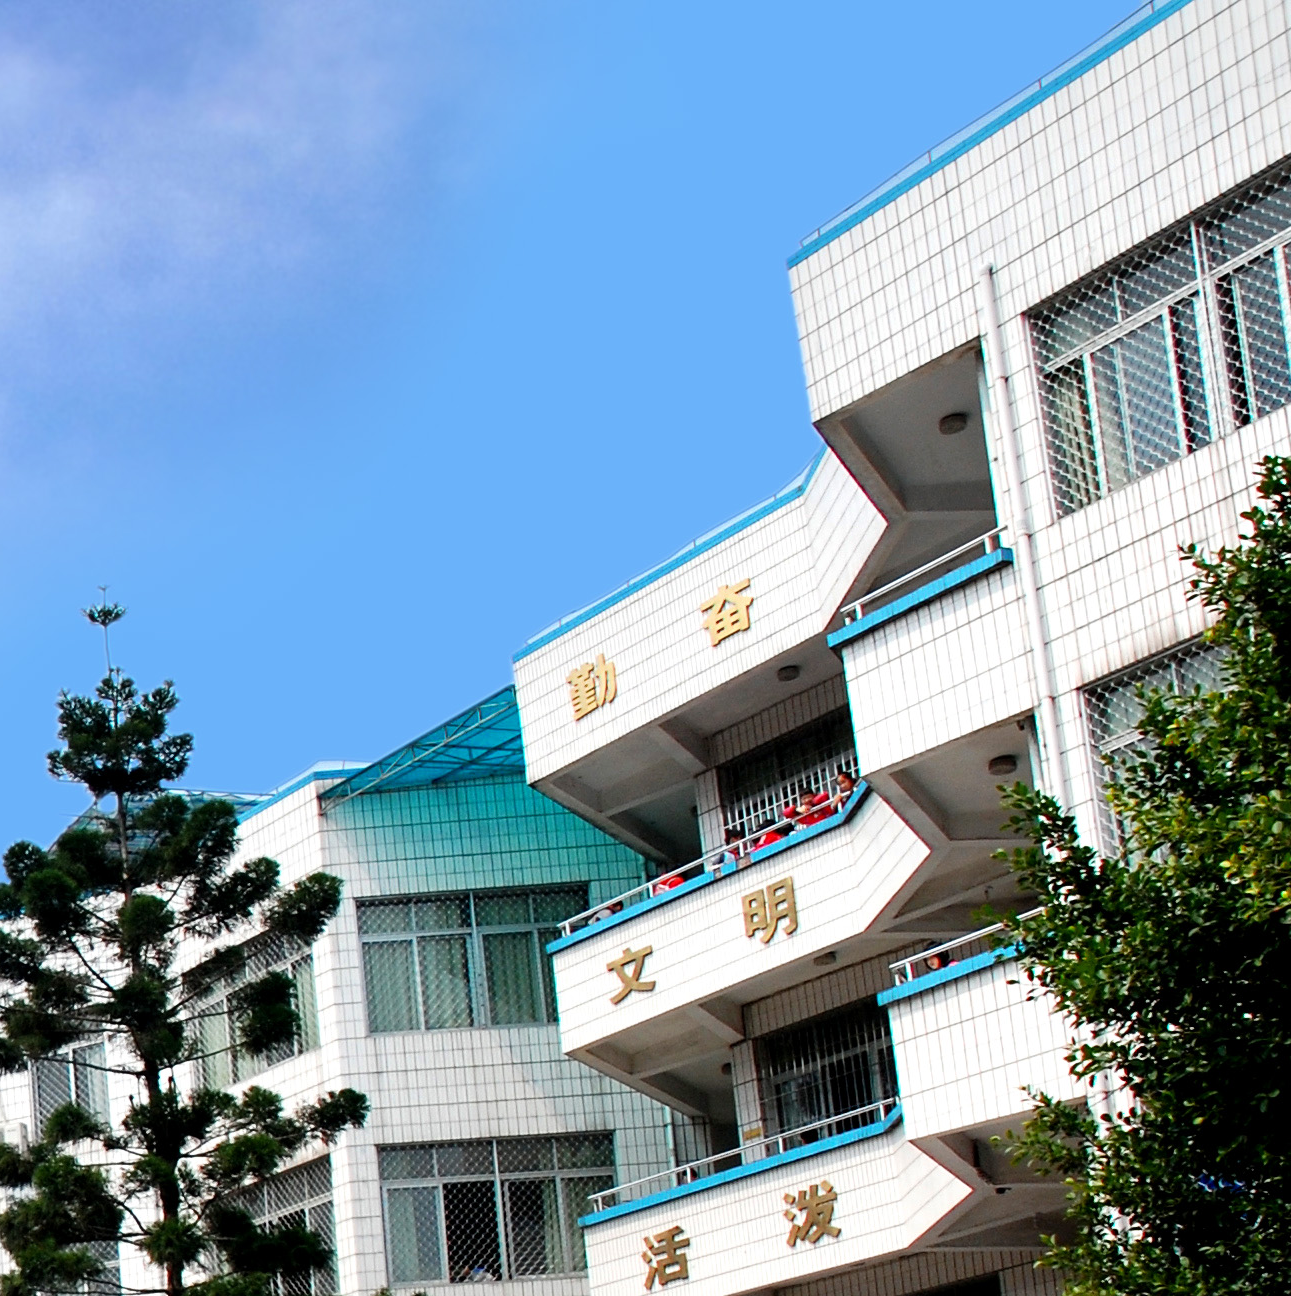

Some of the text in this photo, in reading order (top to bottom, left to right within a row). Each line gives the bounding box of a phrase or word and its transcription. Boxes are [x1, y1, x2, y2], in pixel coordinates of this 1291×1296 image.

[566, 577, 754, 722] 勤奋
[606, 875, 798, 1006] 文明
[641, 1179, 842, 1291] 活泼
